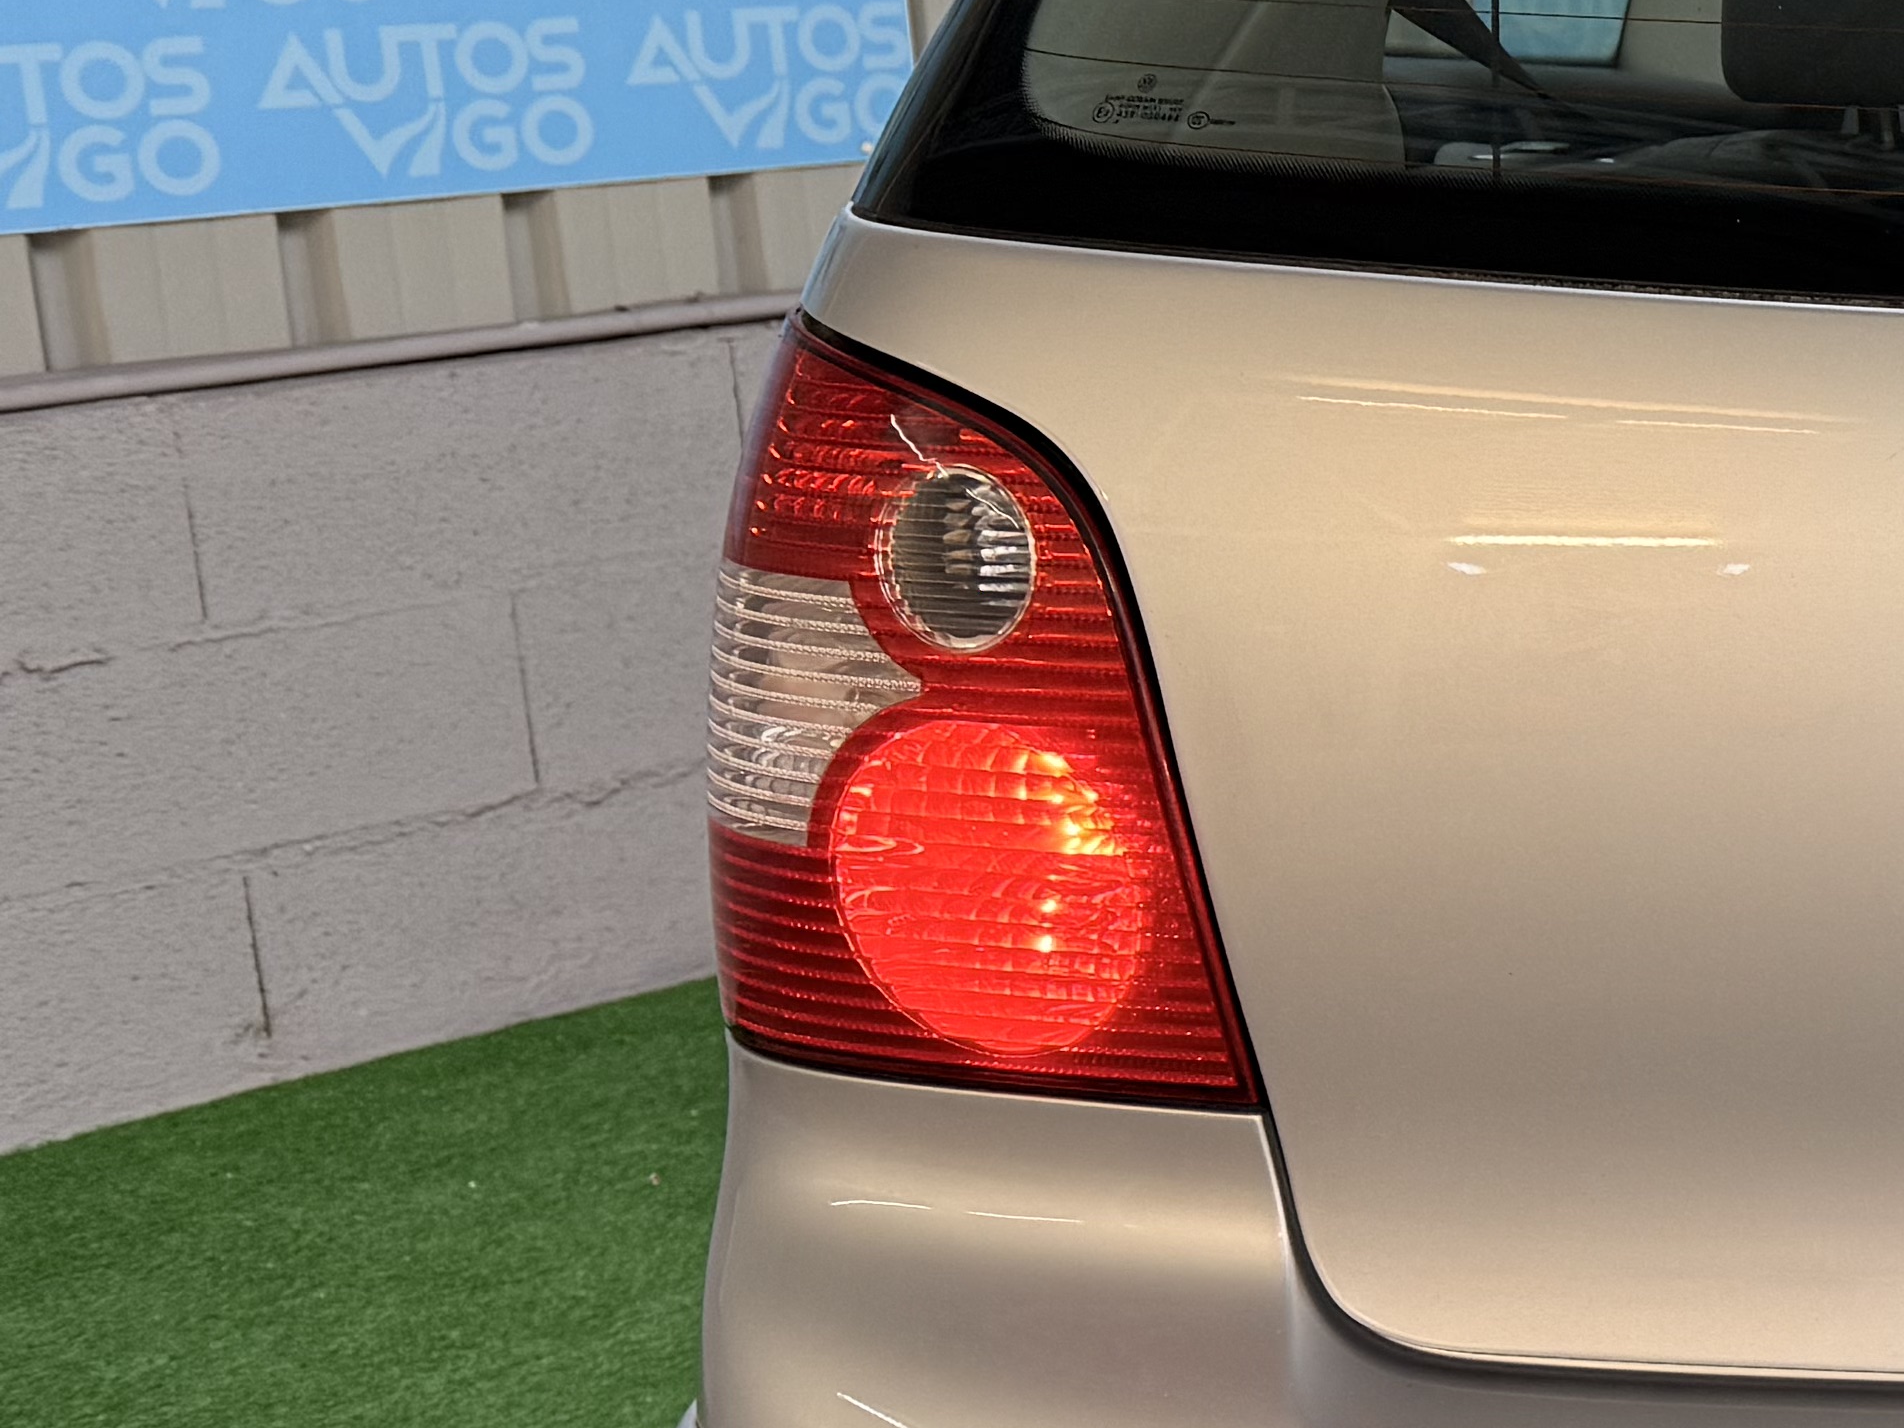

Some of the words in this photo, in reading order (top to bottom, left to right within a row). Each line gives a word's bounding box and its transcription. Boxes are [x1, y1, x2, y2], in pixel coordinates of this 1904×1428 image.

[257, 18, 587, 109] AUTOS
[626, 0, 905, 85] AUTOS
[334, 95, 595, 179] VIGO
